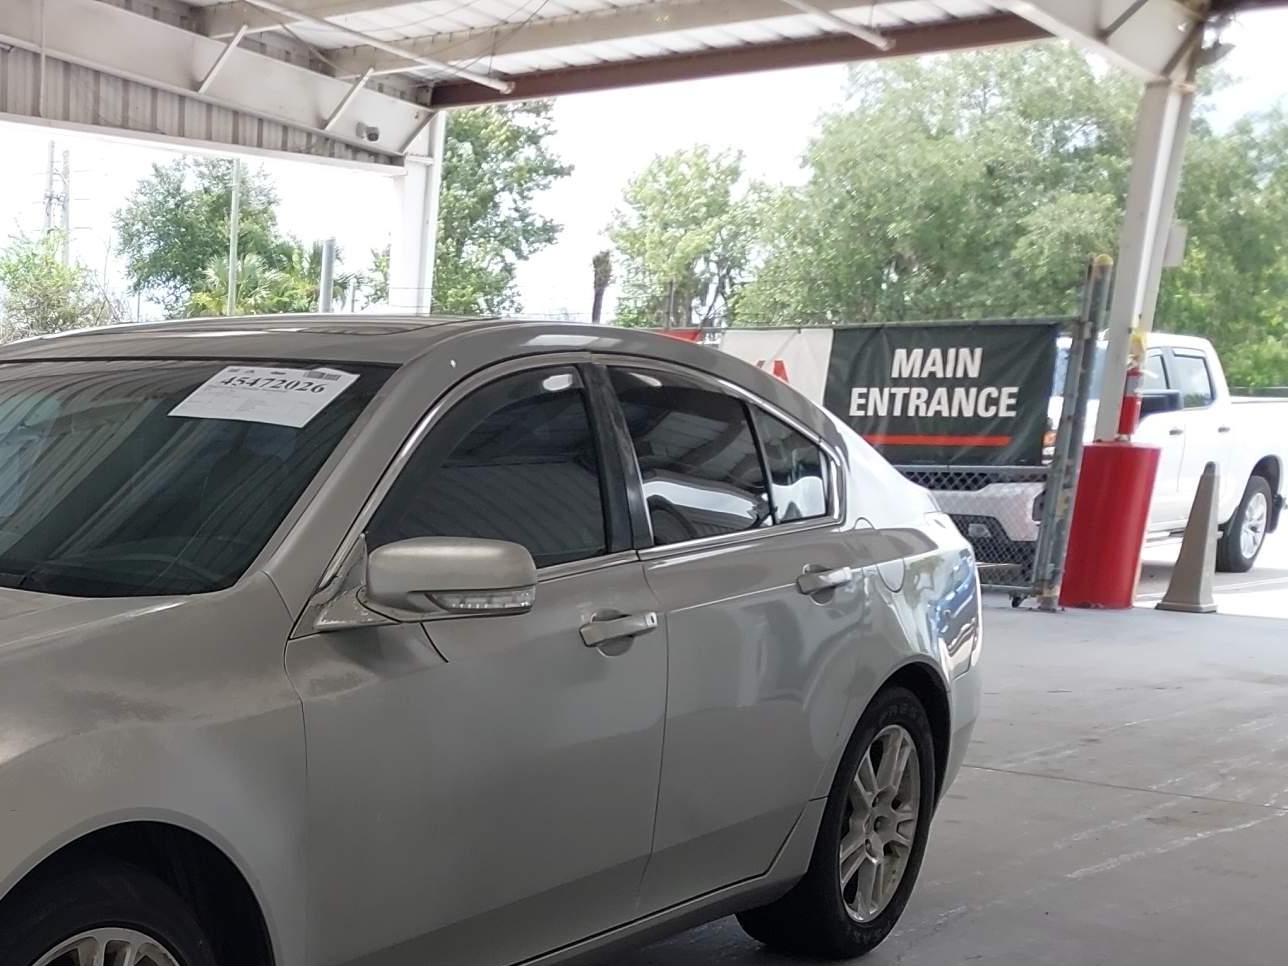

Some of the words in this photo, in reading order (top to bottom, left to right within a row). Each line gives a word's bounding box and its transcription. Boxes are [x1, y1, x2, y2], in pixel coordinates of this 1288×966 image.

[891, 347, 984, 379] MAIN
[220, 375, 327, 394] 45472026
[848, 386, 1020, 418] ENTRANCE
